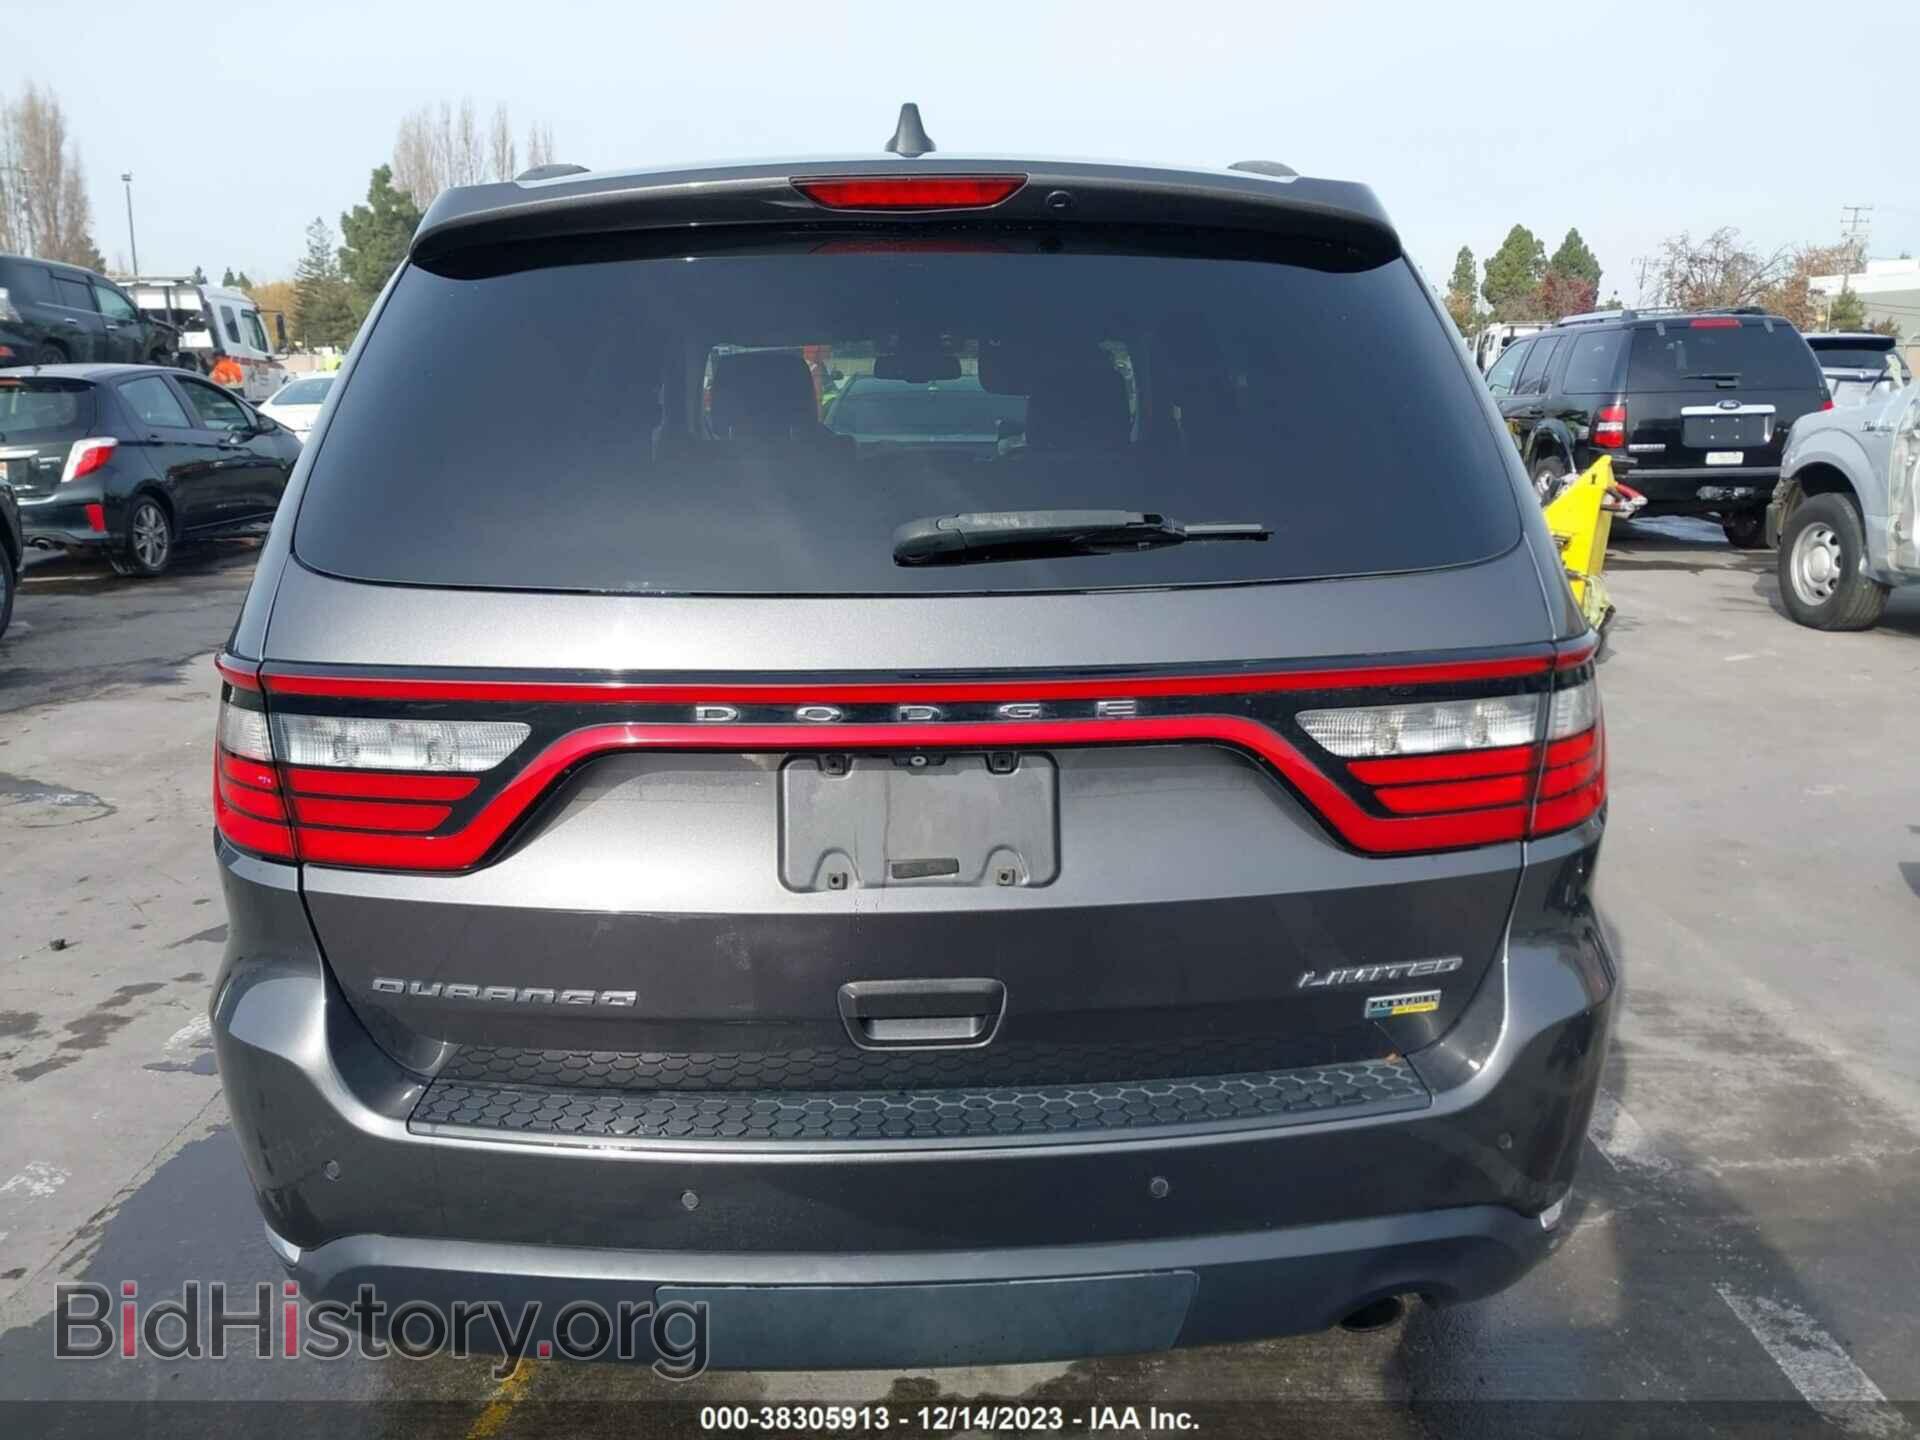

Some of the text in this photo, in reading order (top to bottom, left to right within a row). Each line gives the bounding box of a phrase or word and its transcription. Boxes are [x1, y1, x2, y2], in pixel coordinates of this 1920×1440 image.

[695, 699, 1138, 722] DODGE
[1297, 956, 1463, 988] LIMITED
[371, 977, 639, 1007] DURANGO
